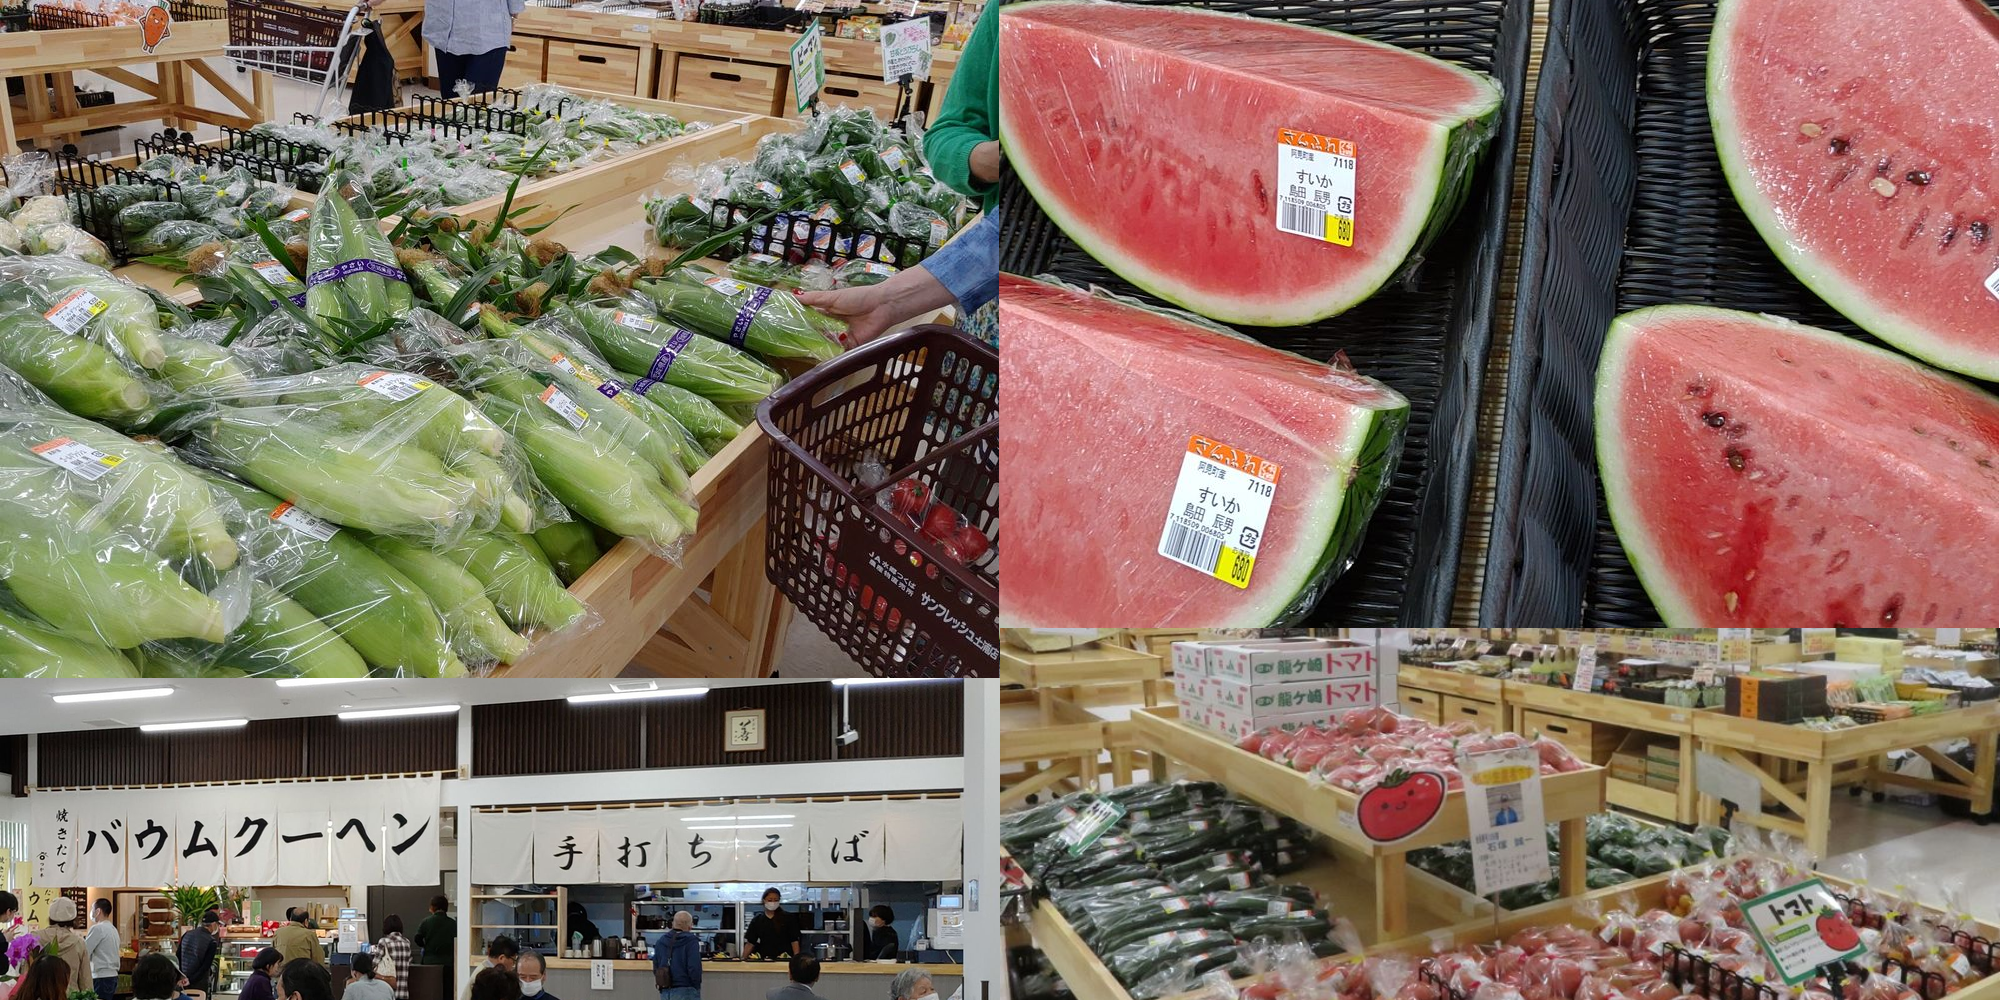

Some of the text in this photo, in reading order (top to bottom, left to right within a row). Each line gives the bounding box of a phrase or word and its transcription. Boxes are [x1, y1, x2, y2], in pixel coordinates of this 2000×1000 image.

[1333, 157, 1354, 170] 7118
[1289, 184, 1306, 199] 島田
[1296, 169, 1332, 188] すいか
[1338, 219, 1351, 241] 680
[1198, 461, 1227, 480] 阿見町産
[1199, 487, 1241, 514] すいか
[1248, 479, 1272, 498] 7118
[1183, 503, 1234, 534] 島田 辰男
[1232, 554, 1250, 582] 680
[921, 592, 999, 660] サンフレッシュ土浦店
[56, 808, 69, 873] 焼きたて
[83, 813, 431, 859] バウムクーヘン
[553, 829, 870, 871] 手打ちそば
[1768, 894, 1814, 926] トマト
